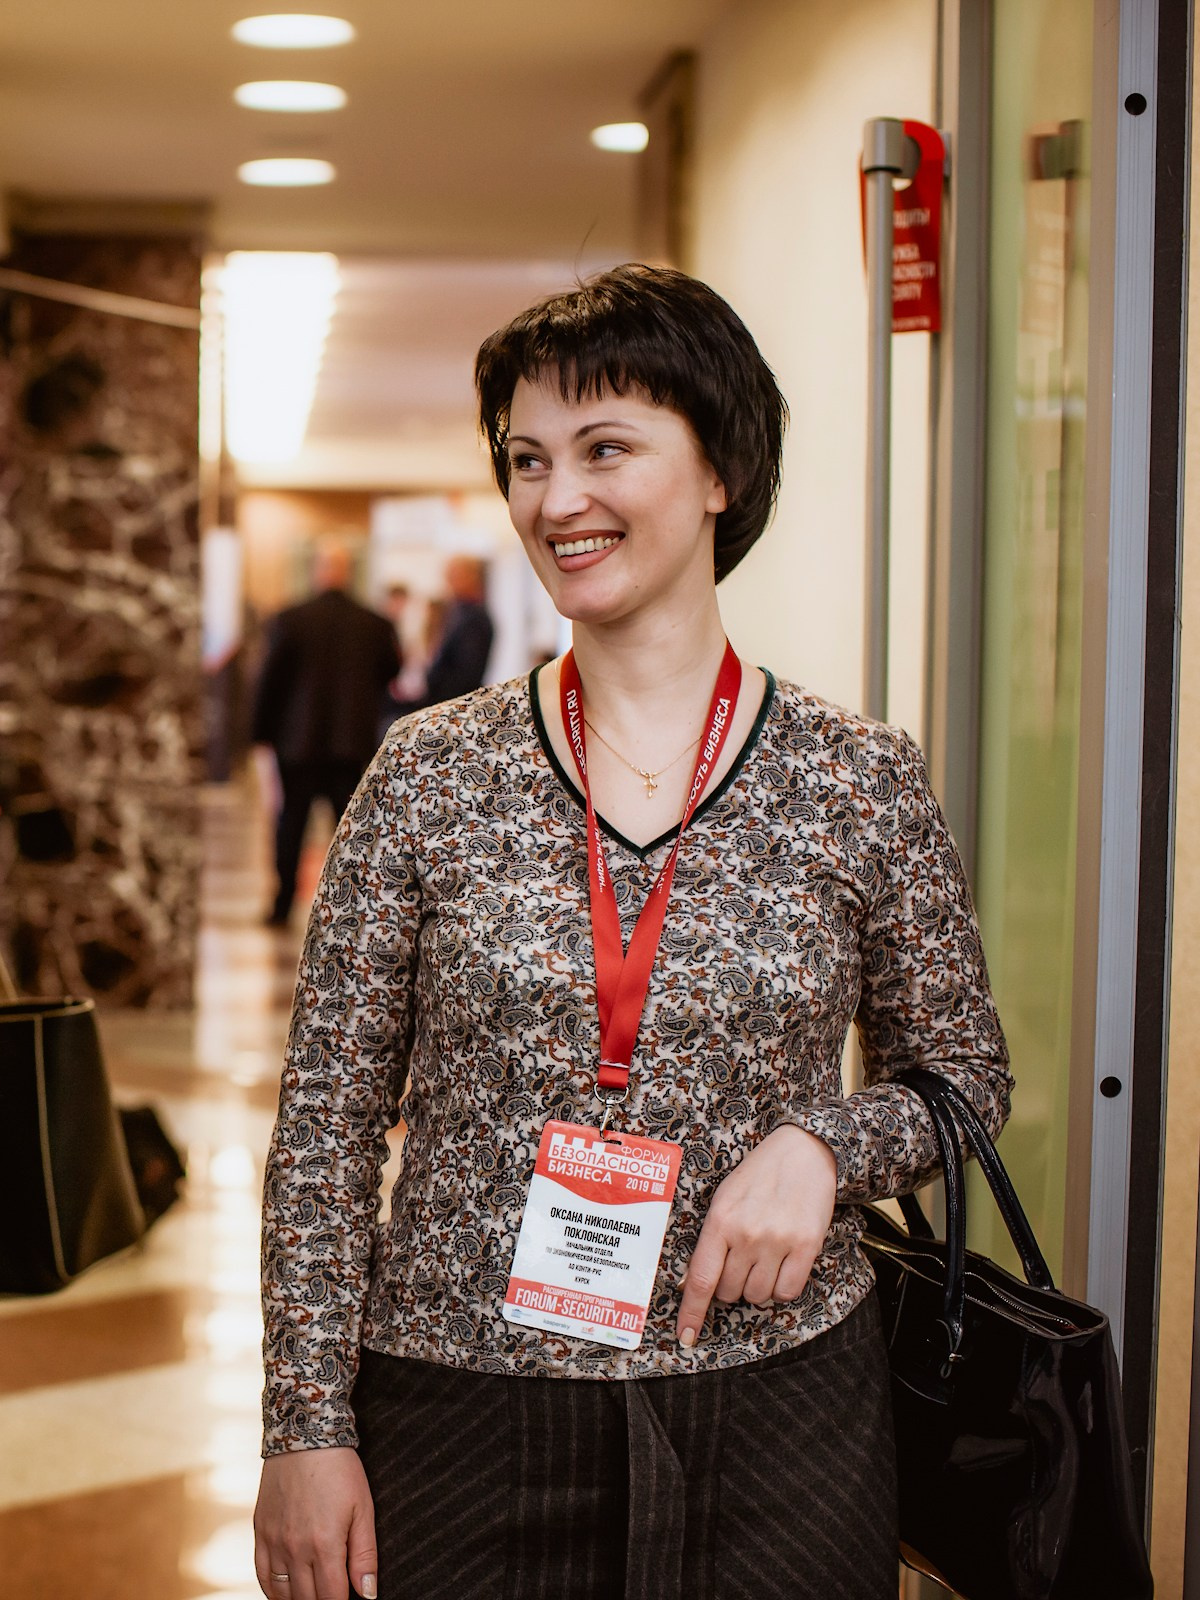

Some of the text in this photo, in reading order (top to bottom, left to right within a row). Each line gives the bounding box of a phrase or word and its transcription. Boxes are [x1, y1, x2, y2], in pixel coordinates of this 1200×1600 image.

[703, 697, 731, 763] БИЗНЕСА
[551, 1144, 666, 1179] БЕЗОПАСНОСТЬ
[621, 1145, 670, 1165] ФОРУМ
[548, 1160, 612, 1184] БИЗНЕСА
[626, 1177, 649, 1192] 2019
[550, 1207, 641, 1237] ОКСАНА НИКОЛАЕВНА
[564, 1226, 621, 1248] ПОКЛОНСКАЯ
[566, 1241, 613, 1257] НАЧАЛЬНИК ОТДЕЛА
[593, 1257, 630, 1270] БЕЗОПАСНОСТИ
[515, 1287, 639, 1331] FORUM-SECURITY.RU
[582, 1295, 615, 1309] ПРОГРАММА
